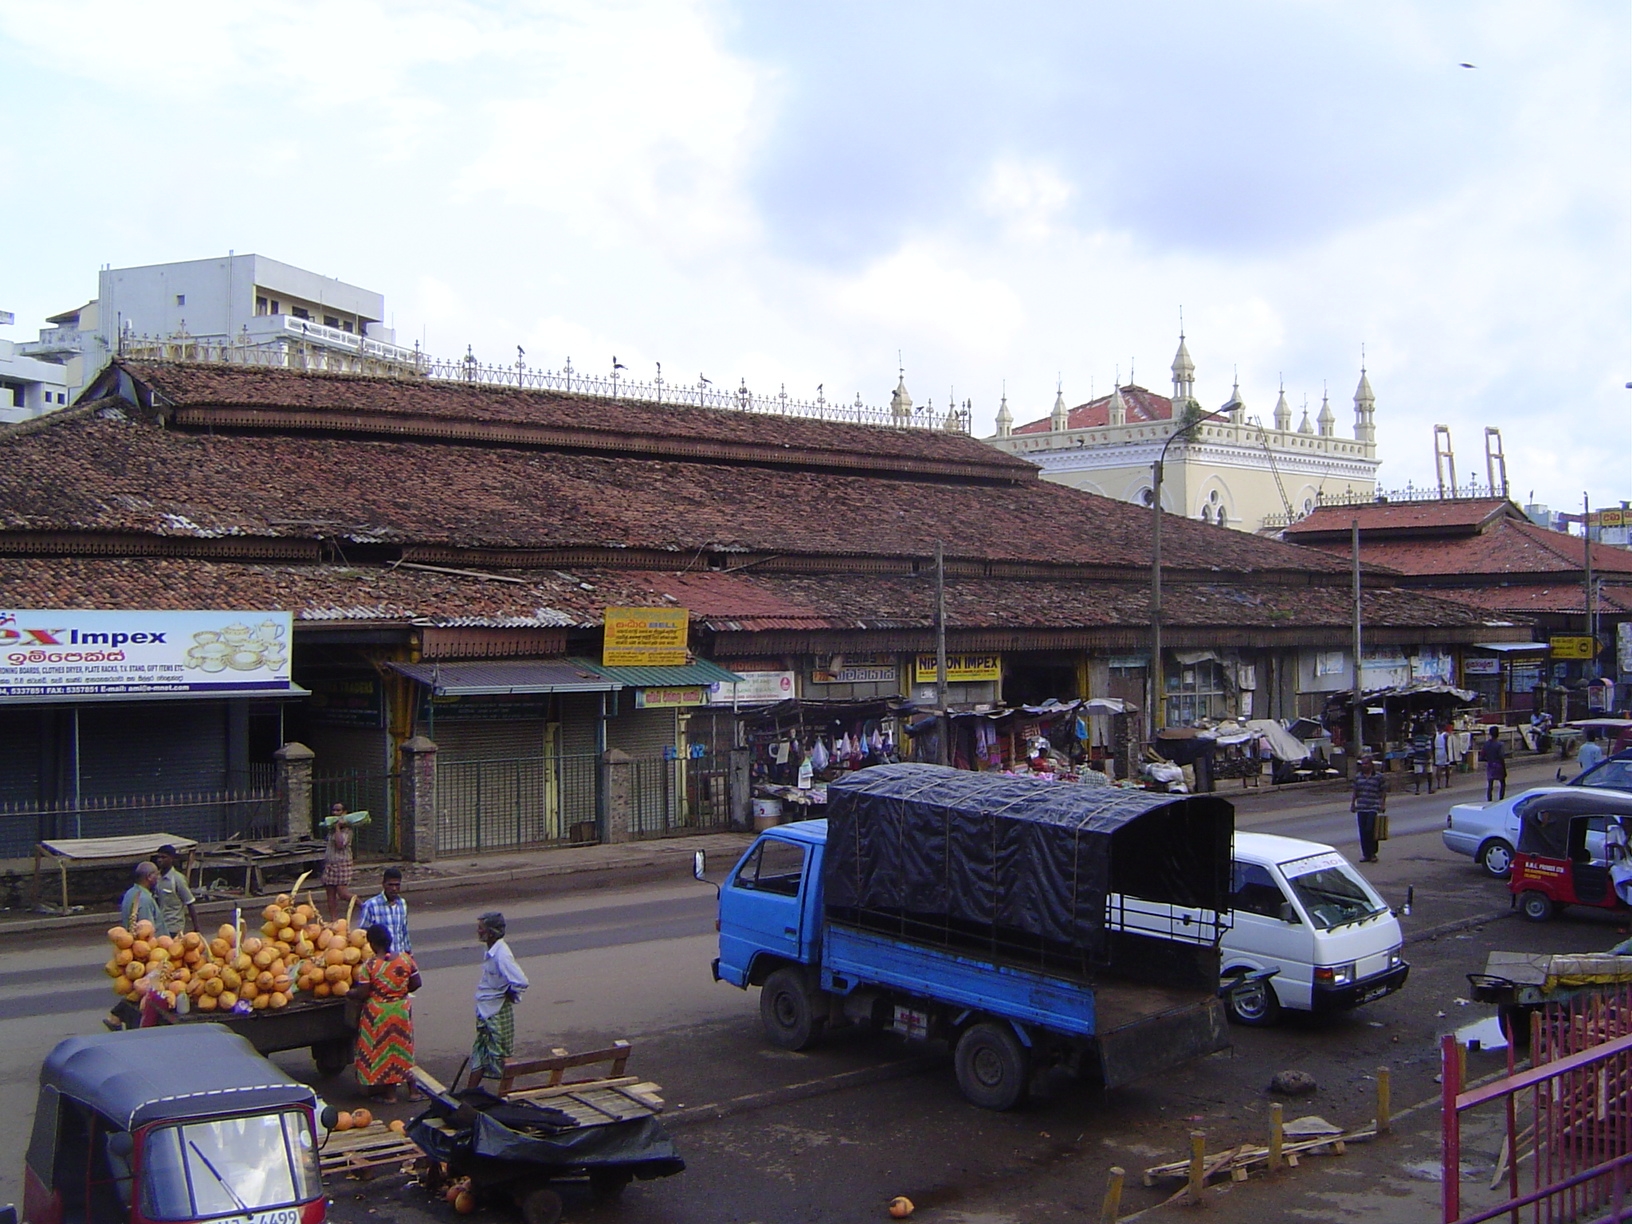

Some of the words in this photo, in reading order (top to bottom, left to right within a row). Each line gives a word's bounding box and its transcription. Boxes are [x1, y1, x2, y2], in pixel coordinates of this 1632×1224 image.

[70, 629, 167, 648] Impex
[19, 667, 41, 676] BOARDS,
[42, 666, 64, 675] CLOTHES
[66, 666, 83, 675] DRYER,
[85, 665, 100, 674] PLATE
[101, 665, 119, 674] RACKS,
[147, 664, 158, 673] GIFT
[159, 664, 173, 672] ITEMS
[918, 656, 962, 671] NIPON
[964, 656, 998, 669] IMPEX
[46, 687, 64, 695] FAX:
